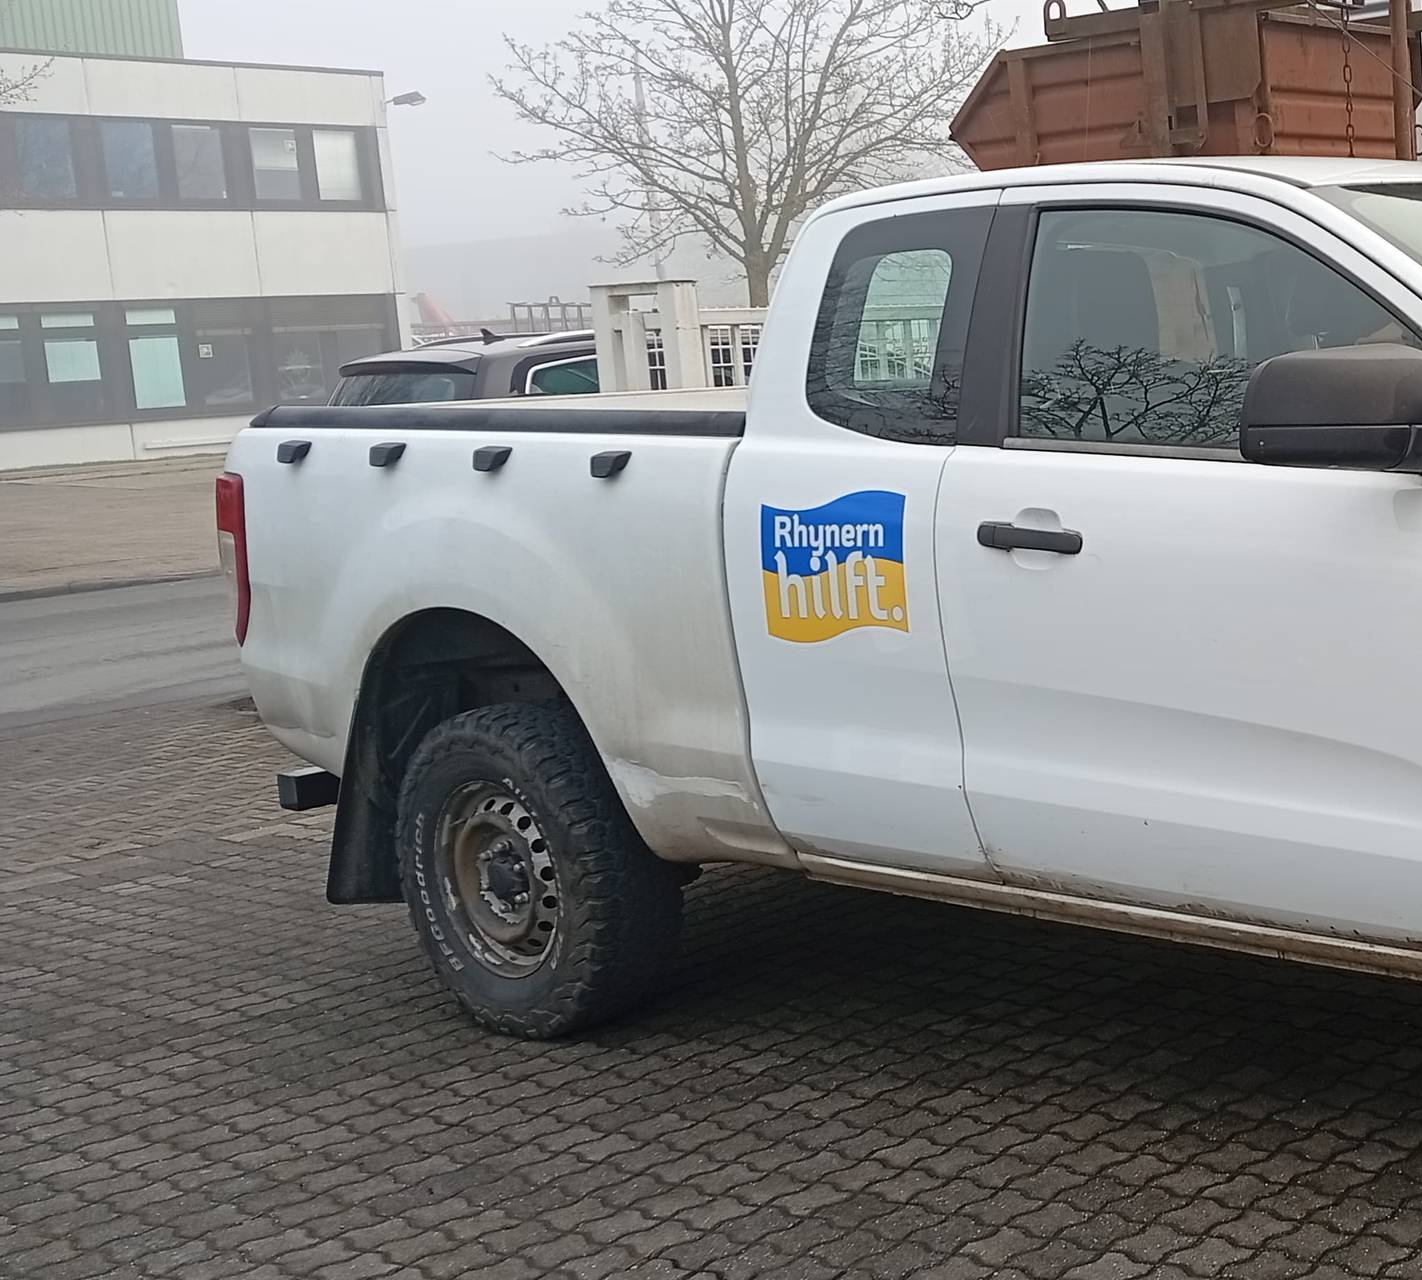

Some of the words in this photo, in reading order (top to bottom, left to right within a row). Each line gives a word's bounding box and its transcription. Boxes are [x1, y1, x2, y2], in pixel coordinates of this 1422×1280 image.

[774, 513, 884, 557] Rhynern
[774, 550, 904, 621] hilft.
[415, 812, 465, 972] BFGoodrich
